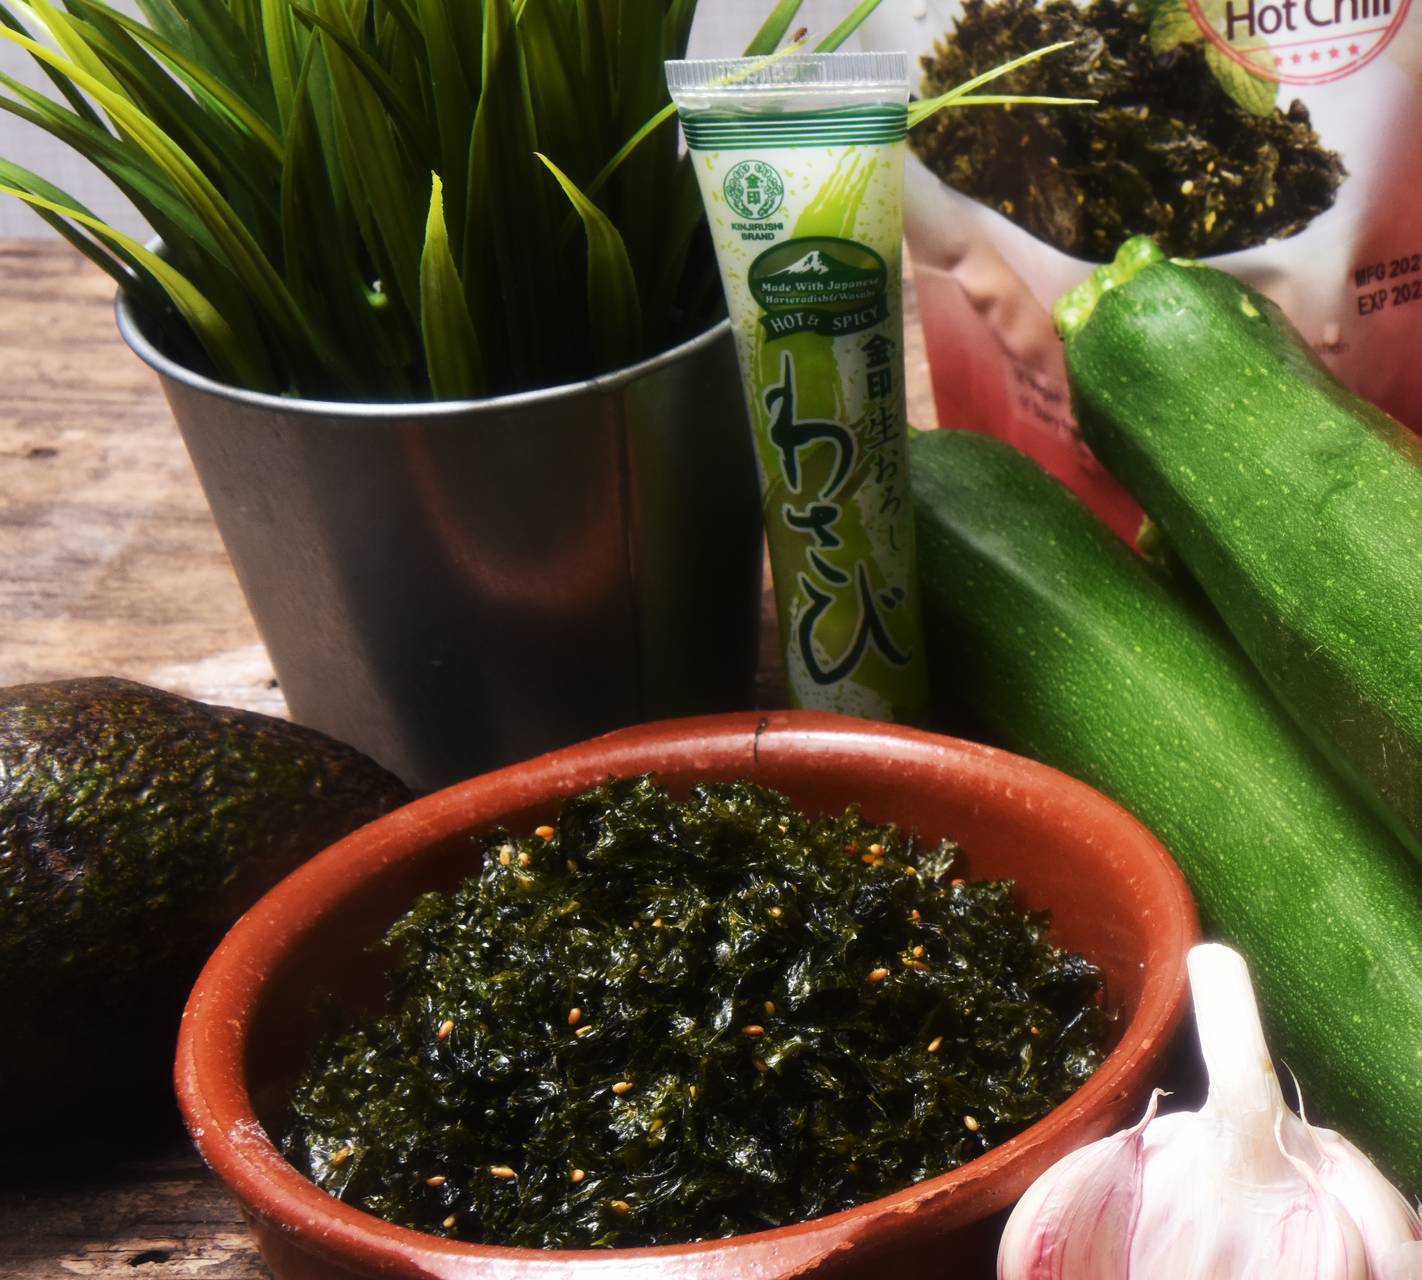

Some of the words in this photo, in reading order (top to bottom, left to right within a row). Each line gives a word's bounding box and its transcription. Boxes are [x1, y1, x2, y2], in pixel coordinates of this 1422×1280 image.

[1226, 1, 1297, 40] Hot
[731, 222, 784, 231] KINJIRUSHI
[741, 232, 775, 240] BRAND
[761, 283, 792, 292] Made
[795, 281, 824, 291] With
[827, 278, 879, 290] Japanese
[1355, 263, 1386, 288] MFG
[1358, 290, 1388, 316] EXP
[770, 312, 804, 333] HOT
[832, 306, 879, 330] SPICY
[765, 352, 912, 683] わさび
